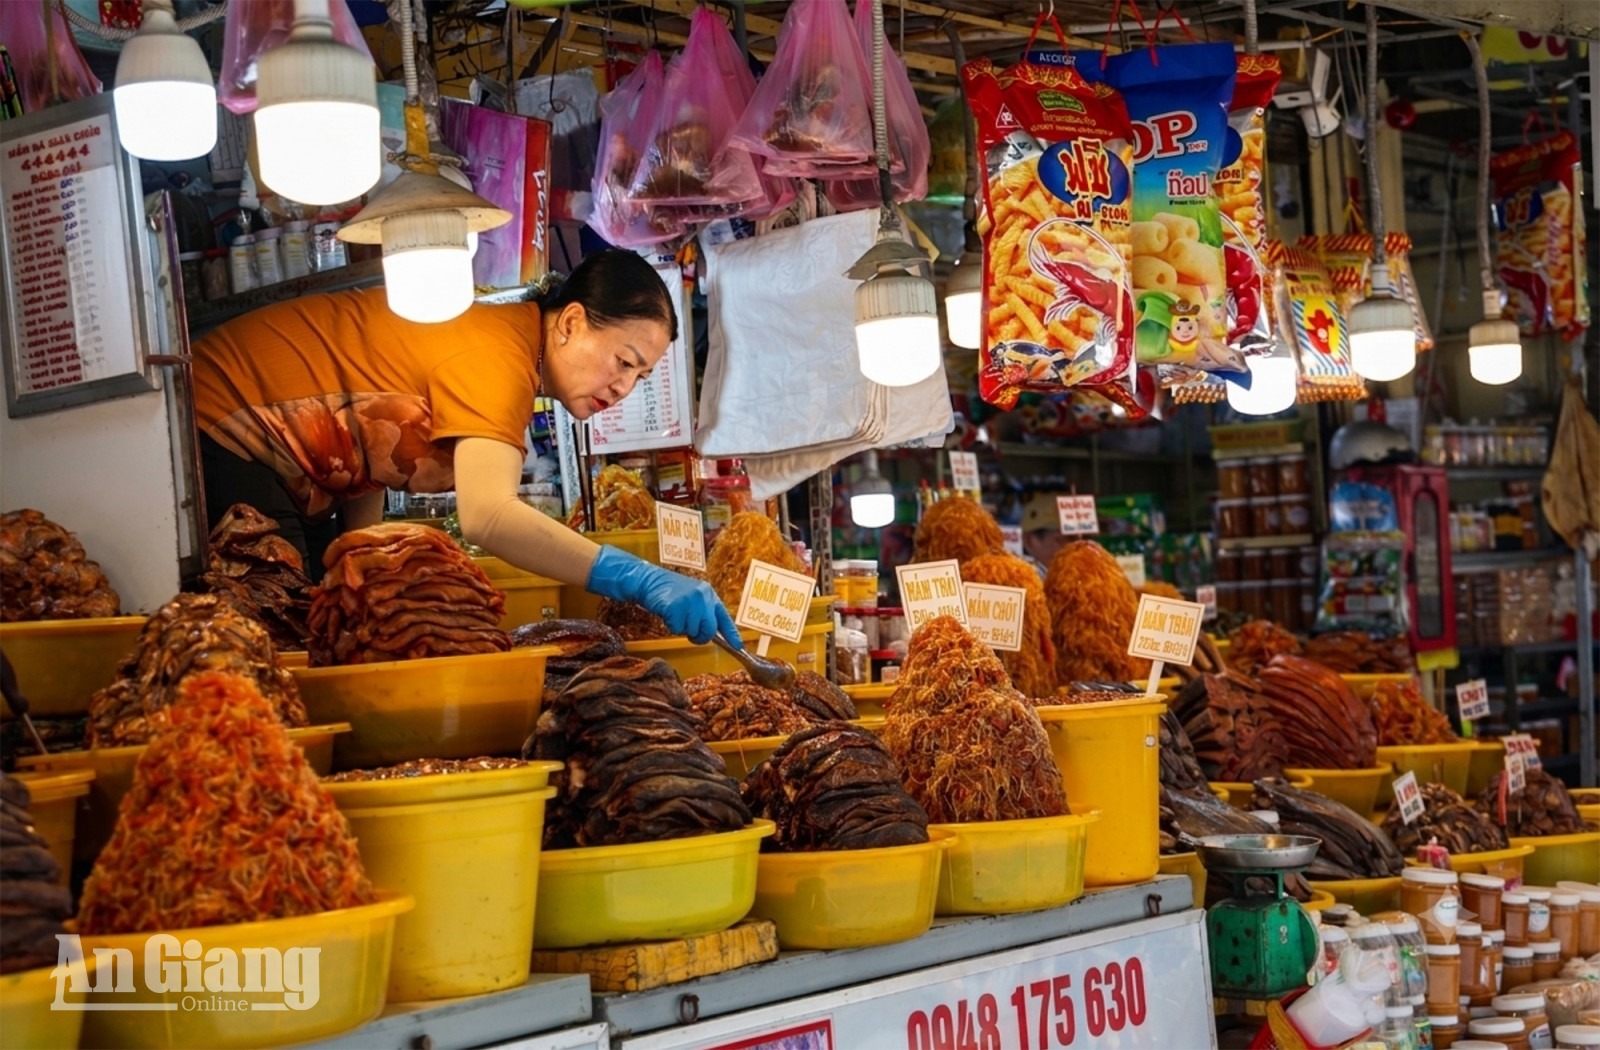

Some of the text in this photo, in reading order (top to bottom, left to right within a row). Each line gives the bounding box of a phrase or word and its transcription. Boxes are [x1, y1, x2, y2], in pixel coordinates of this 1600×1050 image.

[907, 956, 1147, 1050] 0948 175 630
